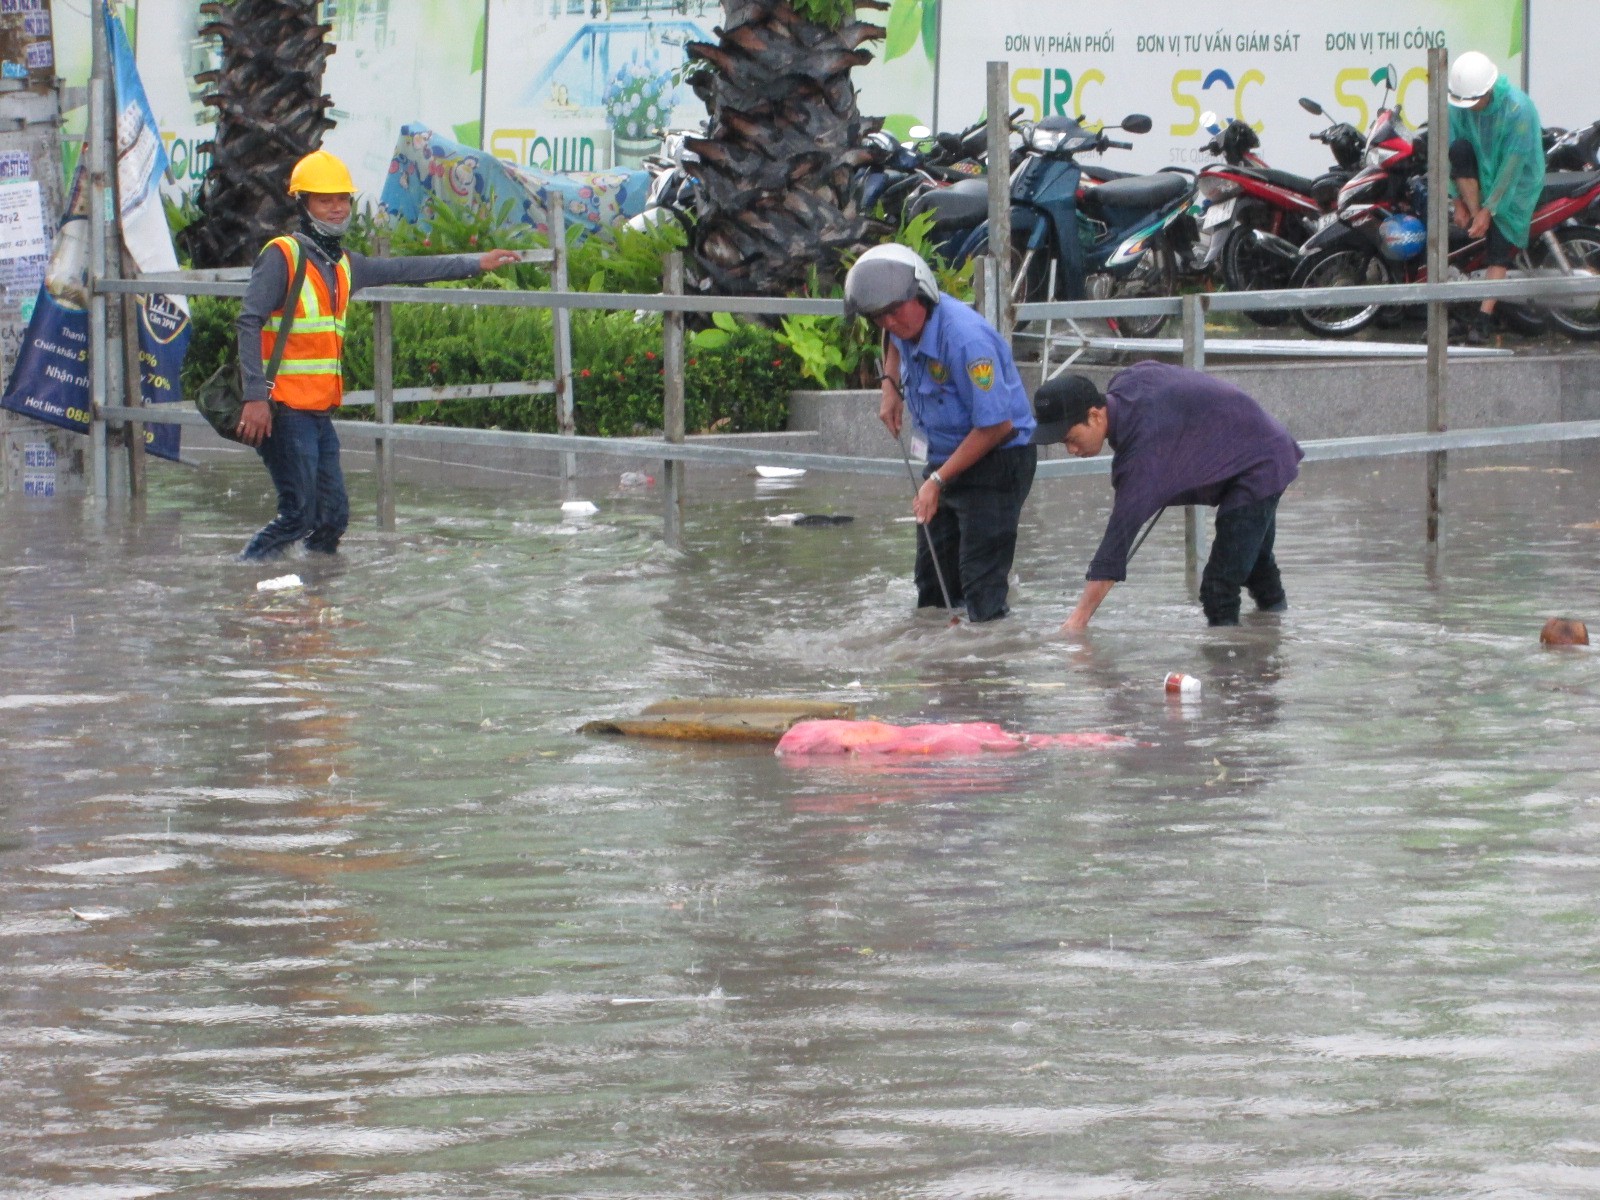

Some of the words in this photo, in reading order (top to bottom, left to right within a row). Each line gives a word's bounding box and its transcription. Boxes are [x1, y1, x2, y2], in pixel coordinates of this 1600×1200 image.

[1005, 34, 1030, 52] ĐƠN
[1034, 35, 1045, 57] VỊ
[1048, 32, 1081, 53] PHÂN
[1085, 28, 1114, 53] PHỐI
[1137, 34, 1164, 53] ĐƠN
[1169, 34, 1180, 57] VỊ
[1184, 33, 1202, 52] TƯ
[1204, 28, 1231, 52] VẤN
[1235, 30, 1269, 52] GIÁM
[1273, 29, 1300, 52] SÁT
[1325, 31, 1356, 51] ĐƠN
[1360, 32, 1373, 55] VỊ
[1378, 31, 1399, 50] THI
[1403, 26, 1446, 49] CÔNG
[1010, 67, 1106, 134] SRC
[62, 326, 87, 342] Thanh
[25, 396, 43, 411] Hot
